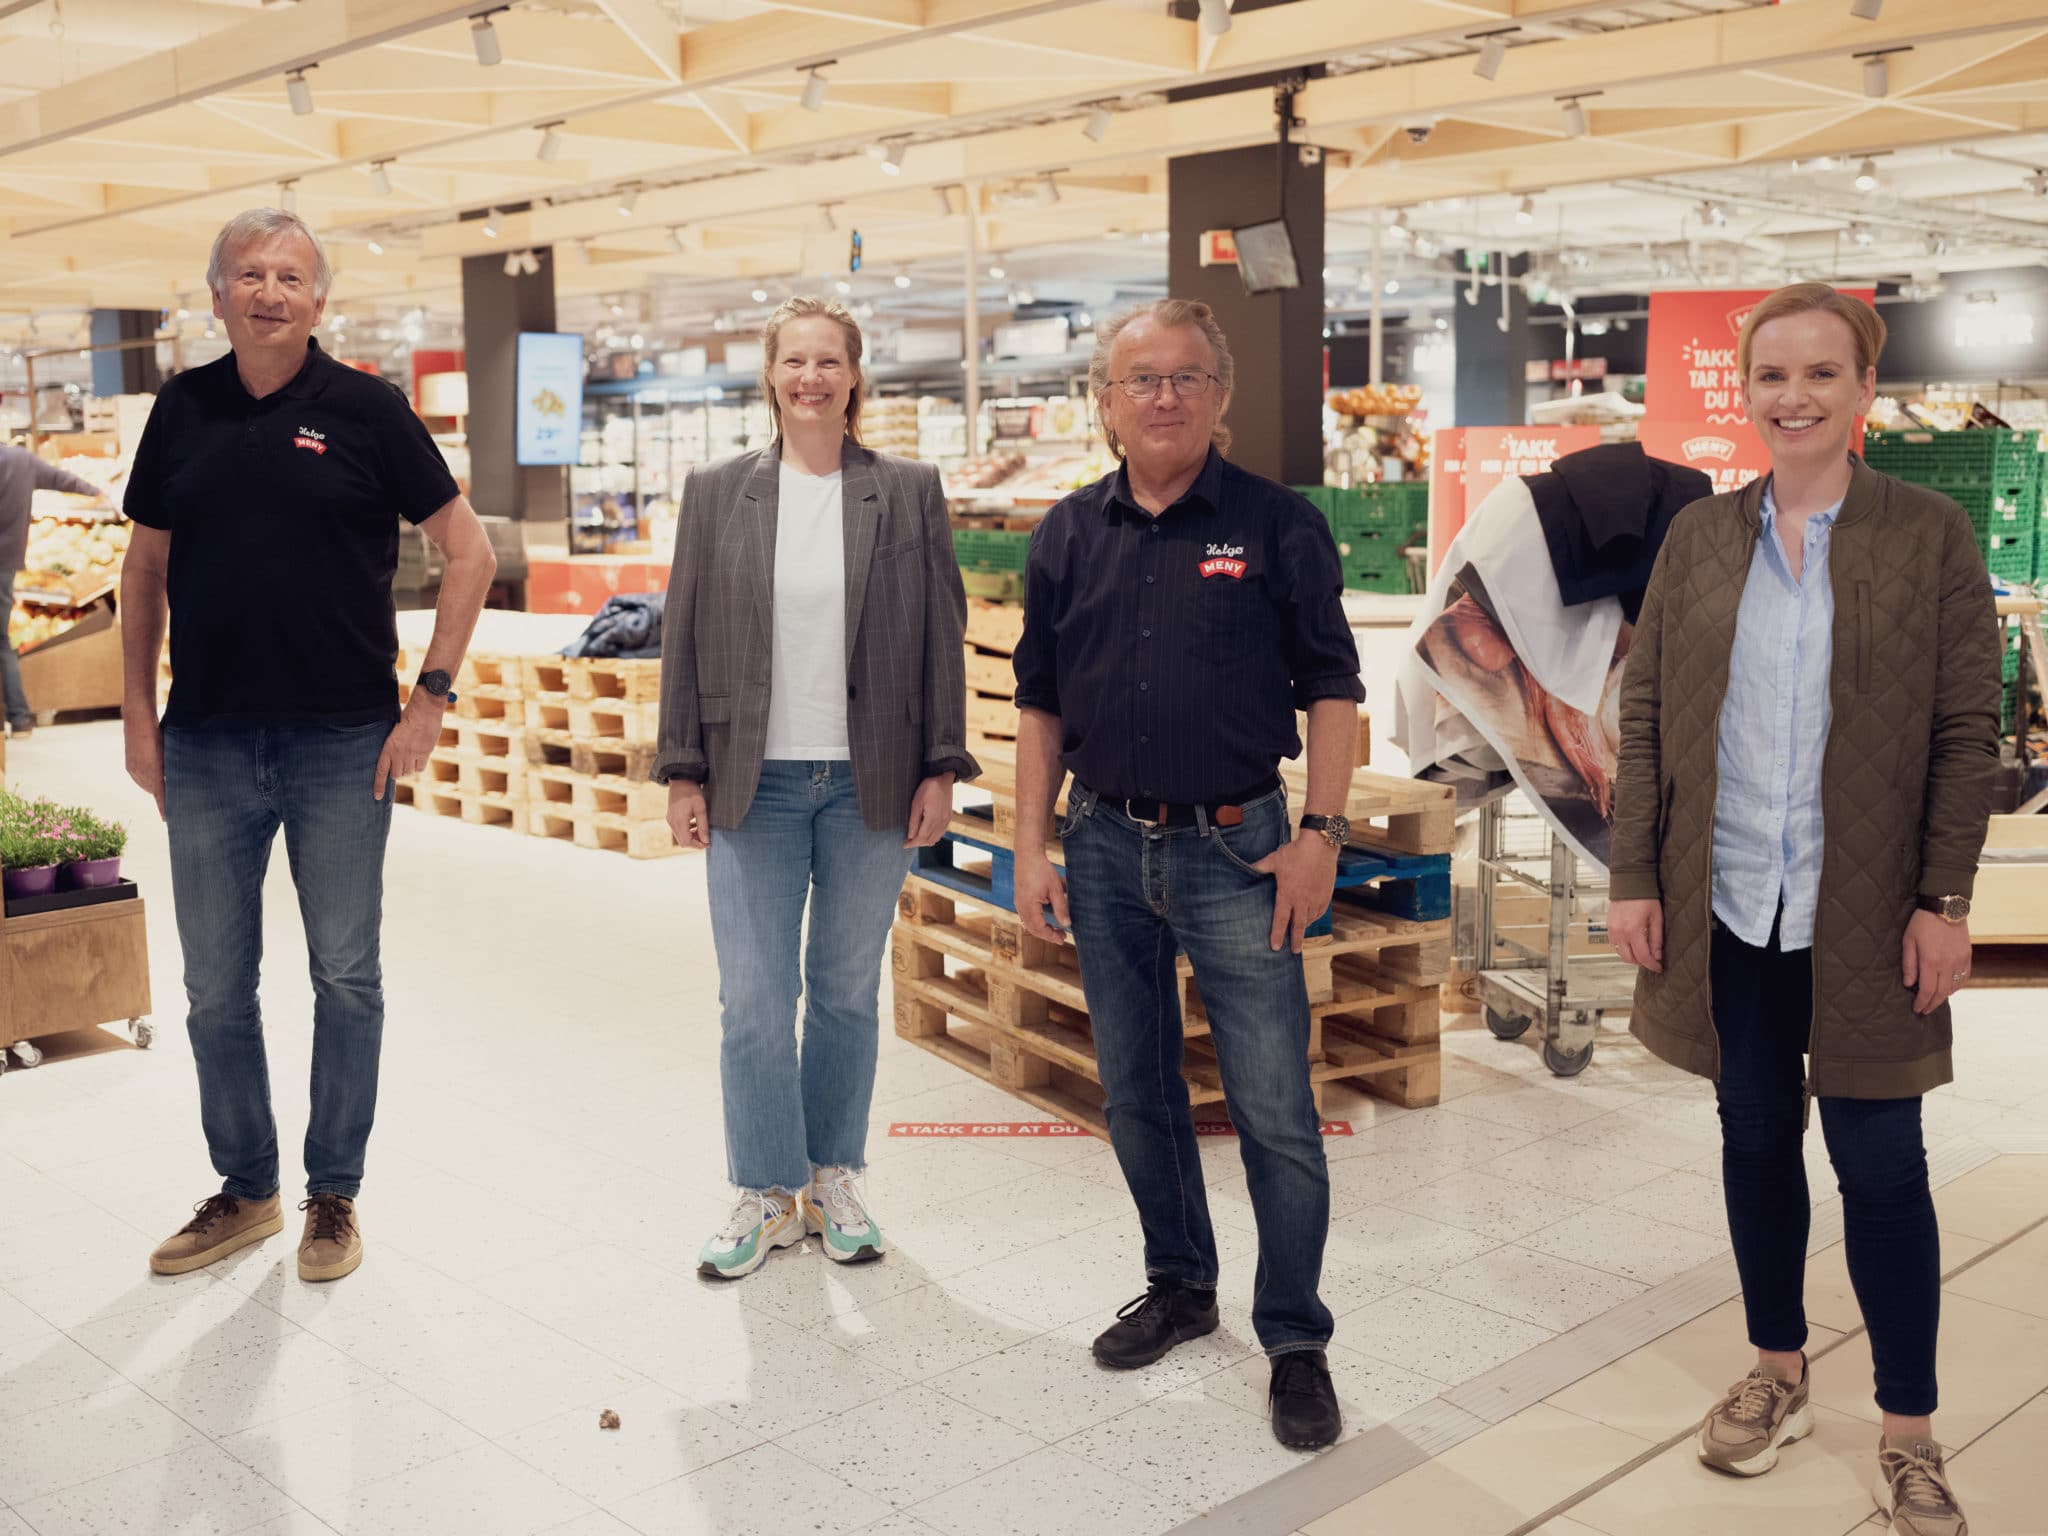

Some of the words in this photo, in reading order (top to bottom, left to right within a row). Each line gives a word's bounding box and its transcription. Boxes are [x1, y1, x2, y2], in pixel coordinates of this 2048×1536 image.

[1693, 350, 1736, 368] TAKK
[1688, 370, 1719, 389] TAR
[1703, 390, 1729, 409] DU
[298, 439, 323, 451] MENY
[1204, 561, 1242, 573] MENY
[910, 1125, 964, 1134] TAKK
[971, 1125, 1010, 1134] FOR
[1018, 1125, 1042, 1134] AT
[1049, 1125, 1080, 1134] DU
